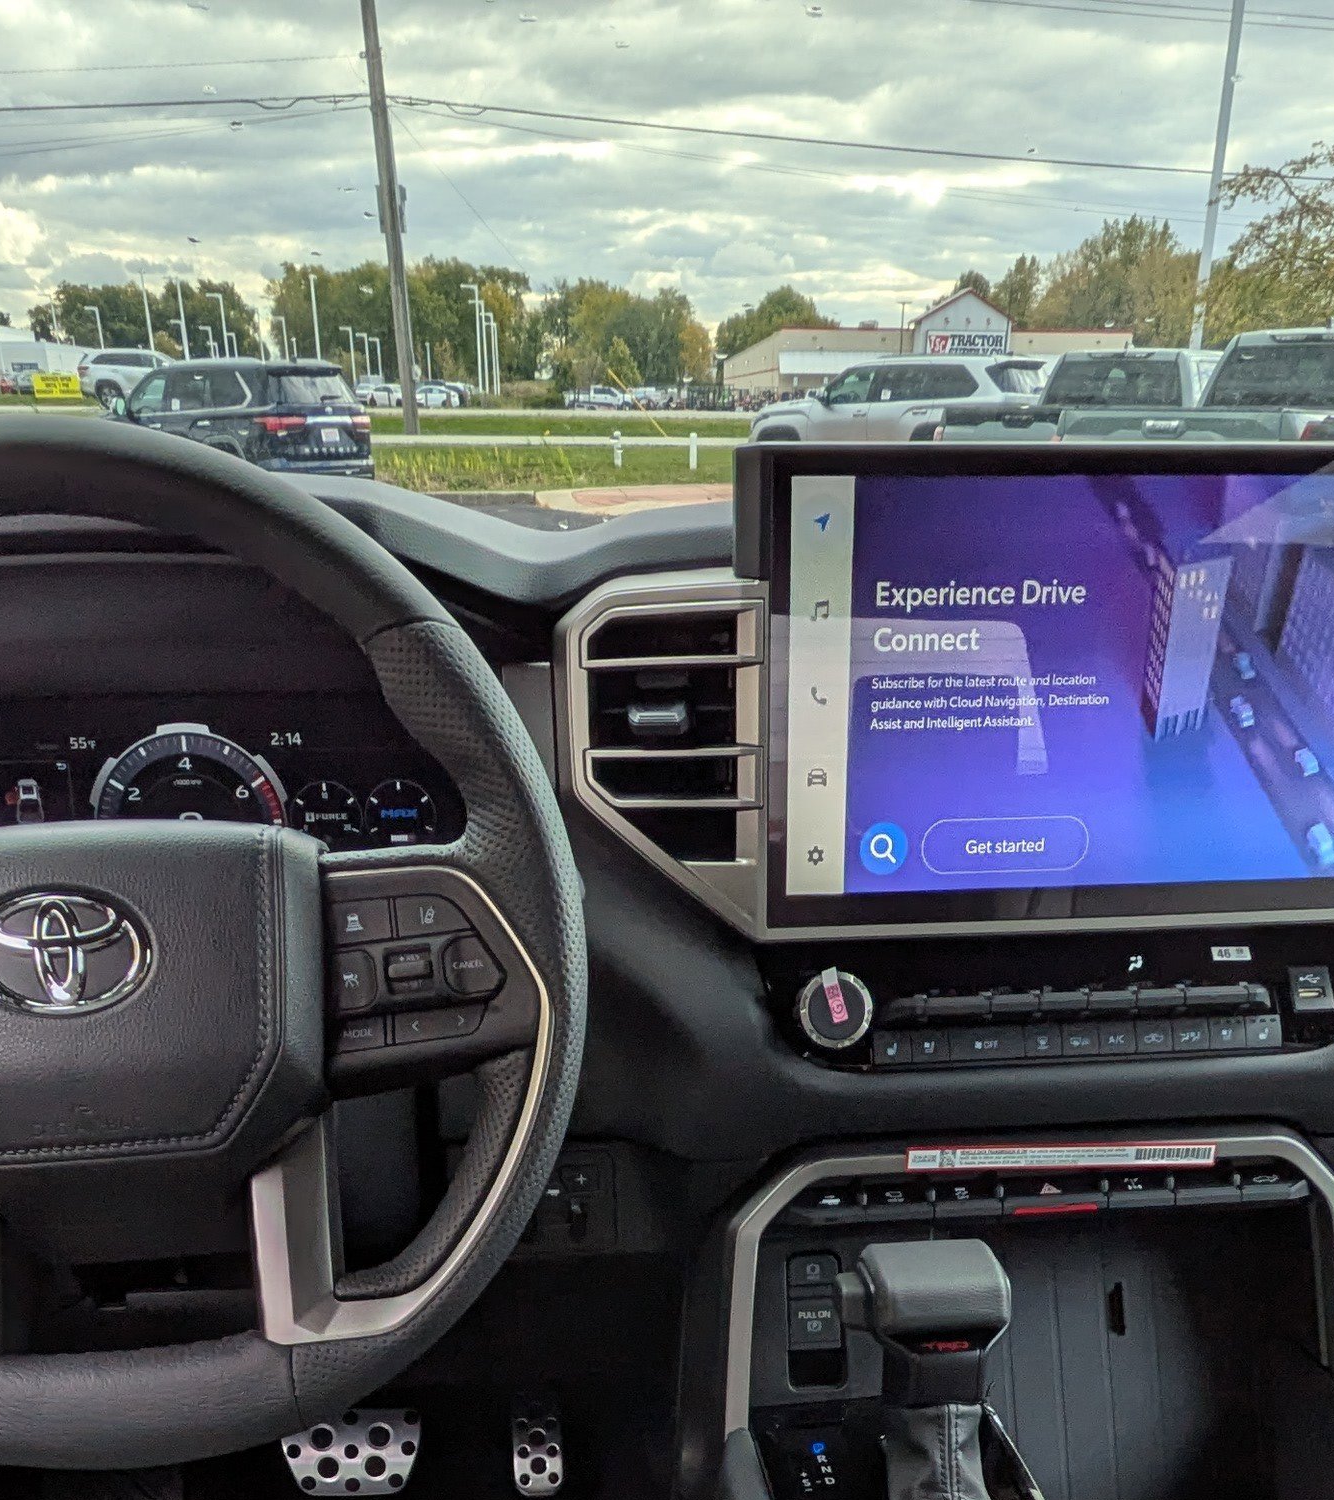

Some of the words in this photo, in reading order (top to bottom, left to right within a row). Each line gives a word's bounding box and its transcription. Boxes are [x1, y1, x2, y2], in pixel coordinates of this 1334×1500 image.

[949, 334, 1003, 347] TRACTOR
[875, 580, 1016, 613] Experience
[1022, 578, 1087, 605] Drive
[873, 627, 980, 652] Connect
[871, 677, 925, 690] Subscribe
[927, 677, 942, 688] for
[945, 676, 963, 688] the
[965, 675, 996, 687] latest
[998, 676, 1027, 687] route
[1030, 675, 1050, 686] and
[1052, 674, 1096, 686] location
[870, 697, 922, 713] guidance
[924, 696, 948, 709] with
[950, 696, 983, 708] Cloud
[1048, 694, 1110, 706] Destination
[870, 717, 902, 730] Assist
[904, 717, 924, 729] and
[926, 717, 982, 731] Intelligent
[983, 714, 1034, 728] Assistant.
[270, 732, 302, 746] 2:14
[177, 757, 193, 771] 4
[127, 787, 142, 801] 2
[235, 785, 250, 799] 6
[965, 839, 993, 854] Get
[995, 837, 1046, 854] started
[452, 960, 485, 970] CANCEL
[798, 1310, 817, 1319] PULL
[817, 1310, 831, 1319] ON
[816, 1454, 828, 1463] R
[820, 1465, 832, 1473] N
[824, 1477, 836, 1485] D
